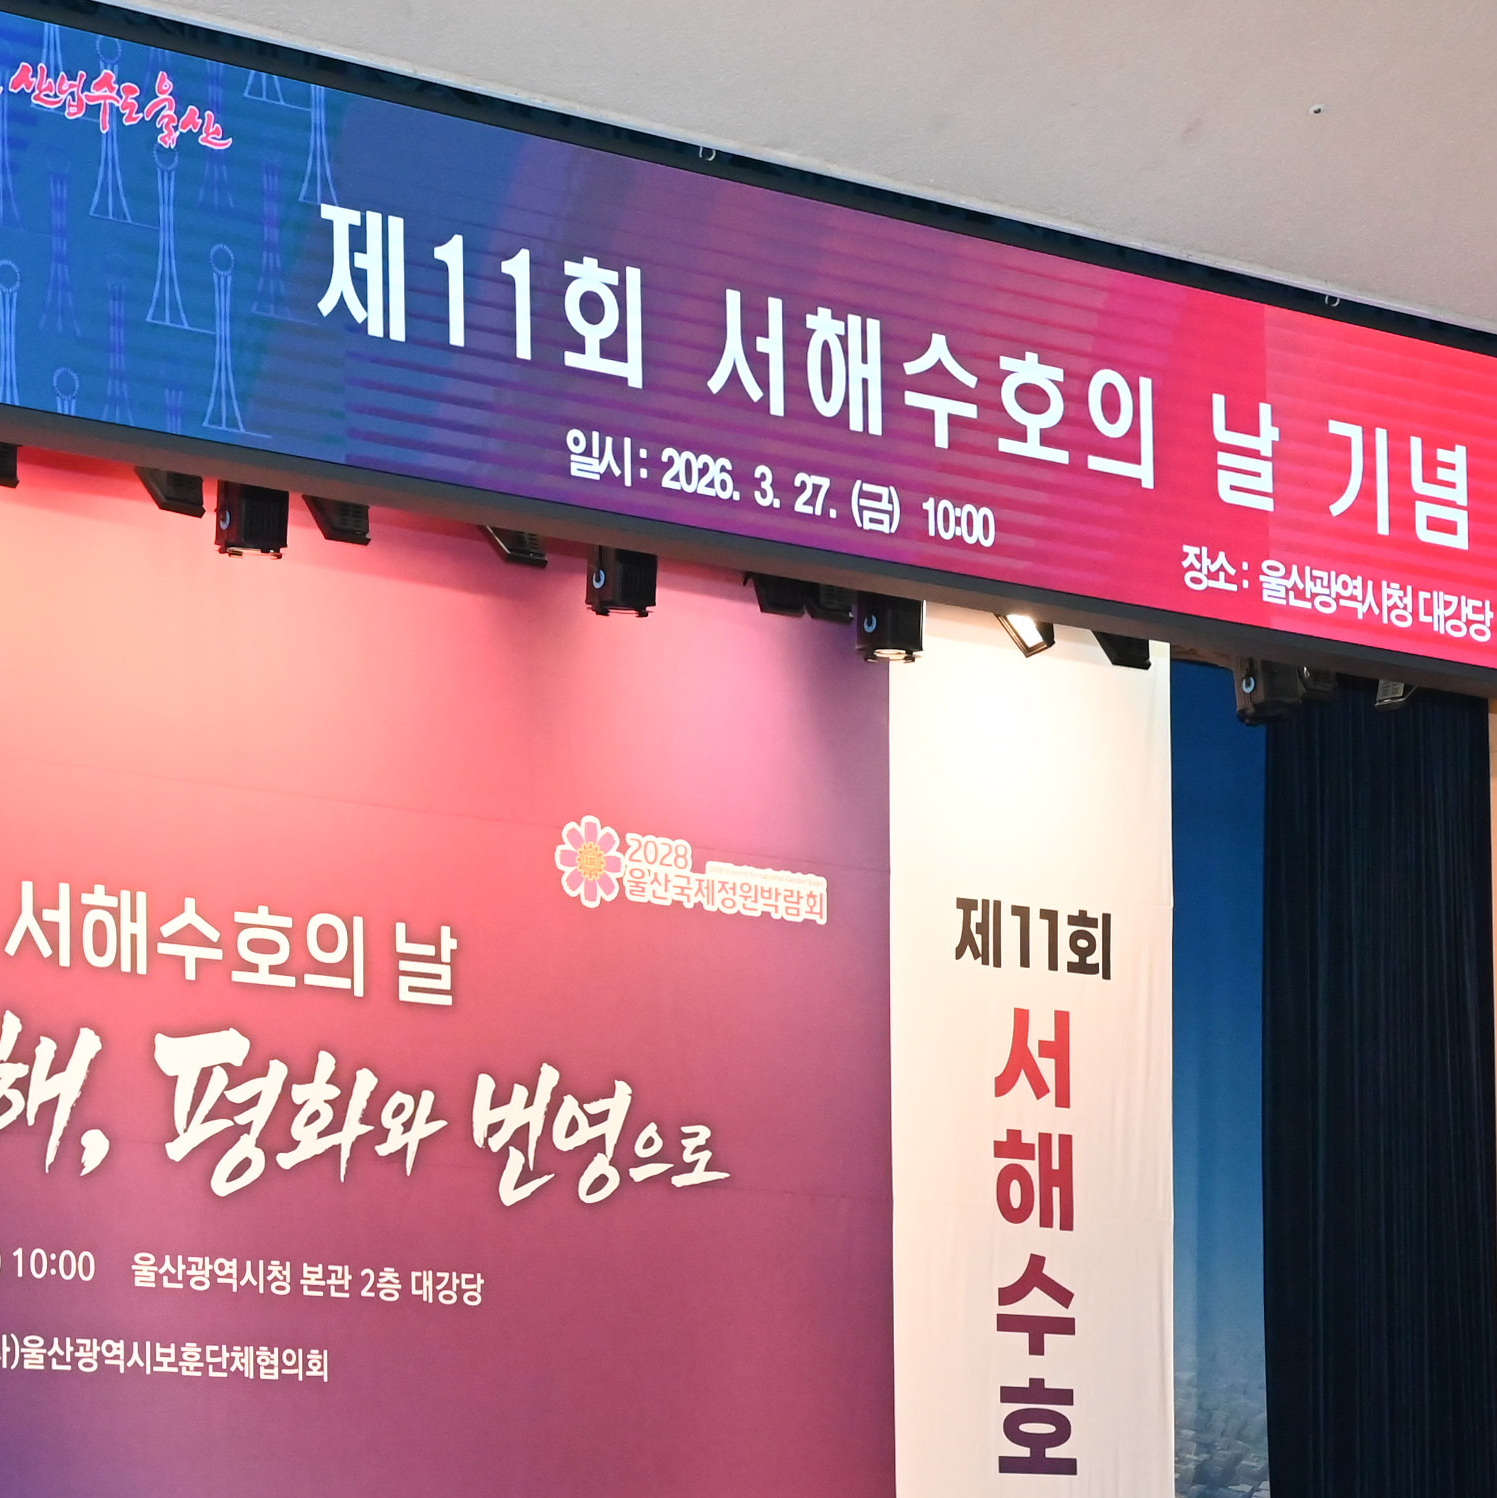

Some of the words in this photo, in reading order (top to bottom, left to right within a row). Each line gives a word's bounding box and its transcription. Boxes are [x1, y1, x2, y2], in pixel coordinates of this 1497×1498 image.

[9, 62, 232, 149] 산업수도울산
[317, 201, 643, 390] 제11회
[707, 286, 1155, 490] 서해수호의
[1213, 391, 1280, 513] 날
[1327, 416, 1469, 552] 기념
[661, 448, 741, 501] 2026.
[754, 465, 781, 508] 3.
[794, 472, 837, 519] 27.
[851, 480, 901, 534] (금)
[923, 497, 996, 548] 10:00
[1259, 559, 1413, 628] 울산광역시청
[1419, 590, 1493, 642] 대강당
[626, 867, 824, 920] 울산국제정원박람회
[628, 837, 688, 869] 2028
[4, 880, 364, 998] 서해수호의
[396, 921, 457, 1006] 날
[954, 896, 1112, 980] 제11회
[154, 1026, 448, 1197] 평화와
[472, 1062, 731, 1206] 번영으로
[12, 1248, 96, 1282] 10:00
[131, 1252, 291, 1295] 울산광역시청
[300, 1261, 352, 1299] 본관
[360, 1266, 402, 1301] 2층
[410, 1269, 484, 1306] 대강당
